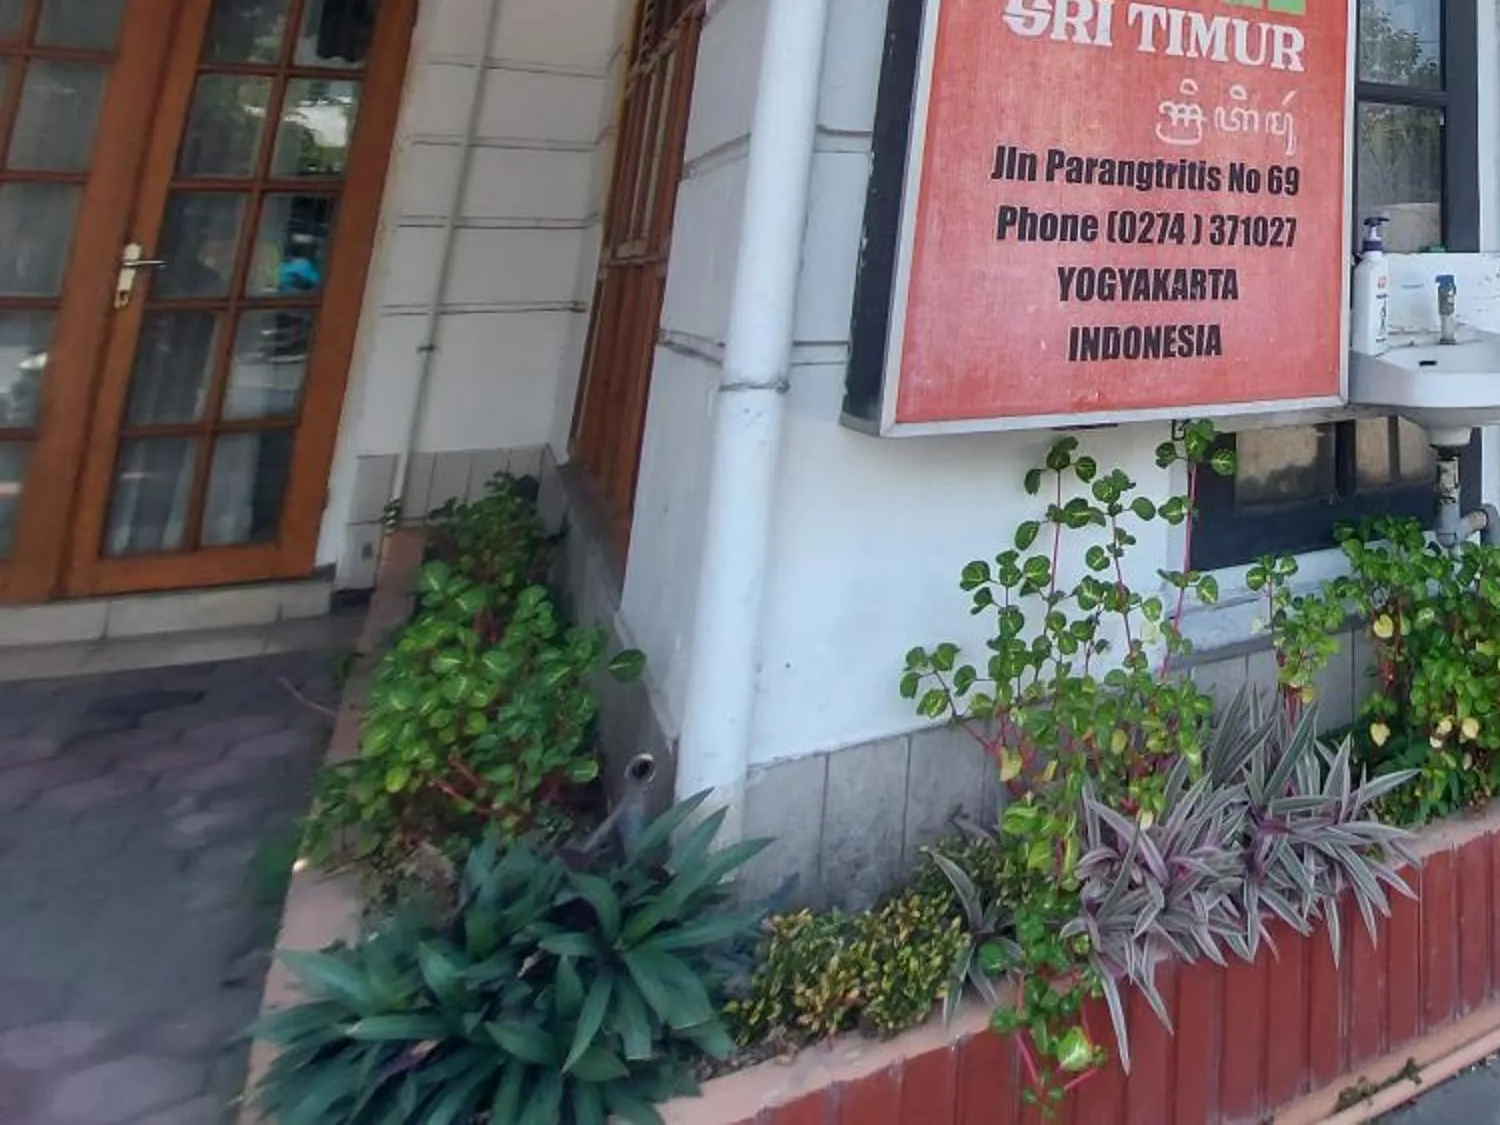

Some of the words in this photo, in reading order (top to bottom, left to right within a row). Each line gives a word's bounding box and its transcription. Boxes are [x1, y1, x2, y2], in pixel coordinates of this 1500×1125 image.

[1127, 2, 1305, 72] TIMUR
[991, 146, 1037, 182] Jln
[1045, 148, 1222, 191] Parangtritis
[1227, 163, 1260, 193] No
[1267, 165, 1299, 196] 69
[996, 205, 1099, 242] Phone
[1209, 214, 1297, 248] 371027
[1057, 266, 1239, 302] YOGYAKARTA
[1068, 324, 1223, 362] INDONESIA
